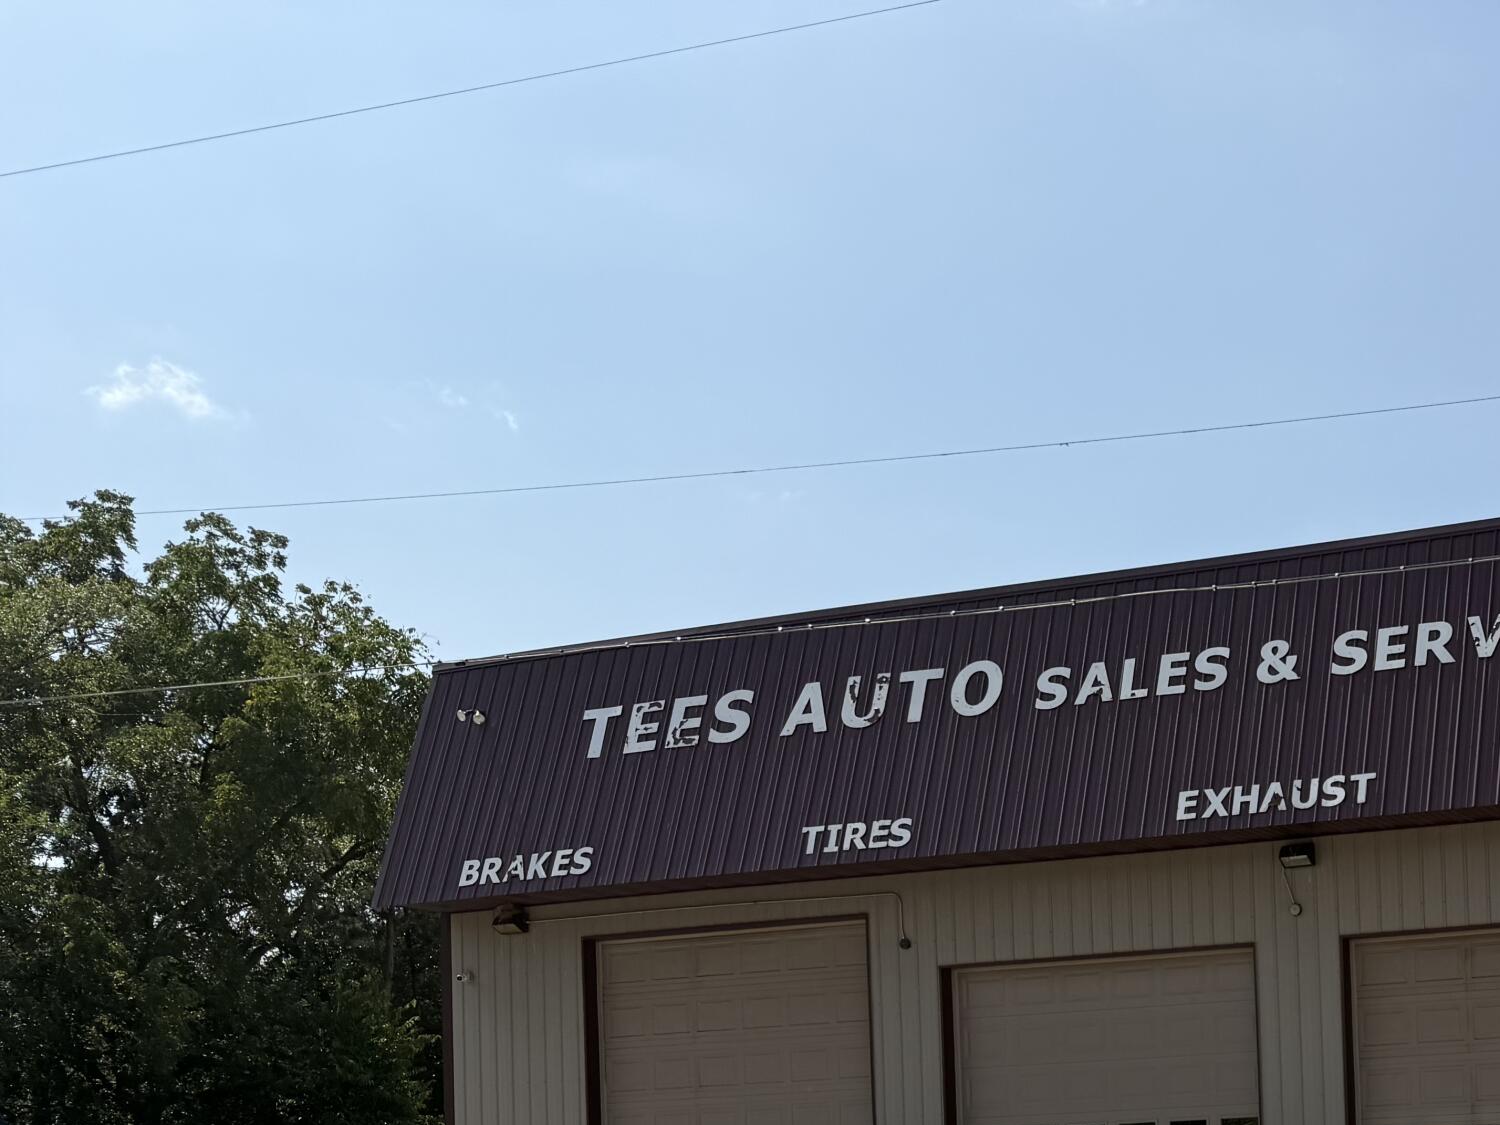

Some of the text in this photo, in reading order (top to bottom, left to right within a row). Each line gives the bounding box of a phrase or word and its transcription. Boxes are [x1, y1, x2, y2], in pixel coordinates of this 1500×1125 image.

[582, 689, 755, 759] TEES
[780, 659, 1003, 737] AUTO
[1034, 646, 1231, 710] SALES
[1256, 639, 1299, 685] &
[1175, 772, 1377, 822] EXHAUST
[801, 816, 913, 855] TIRES
[457, 846, 594, 888] BRAKES
